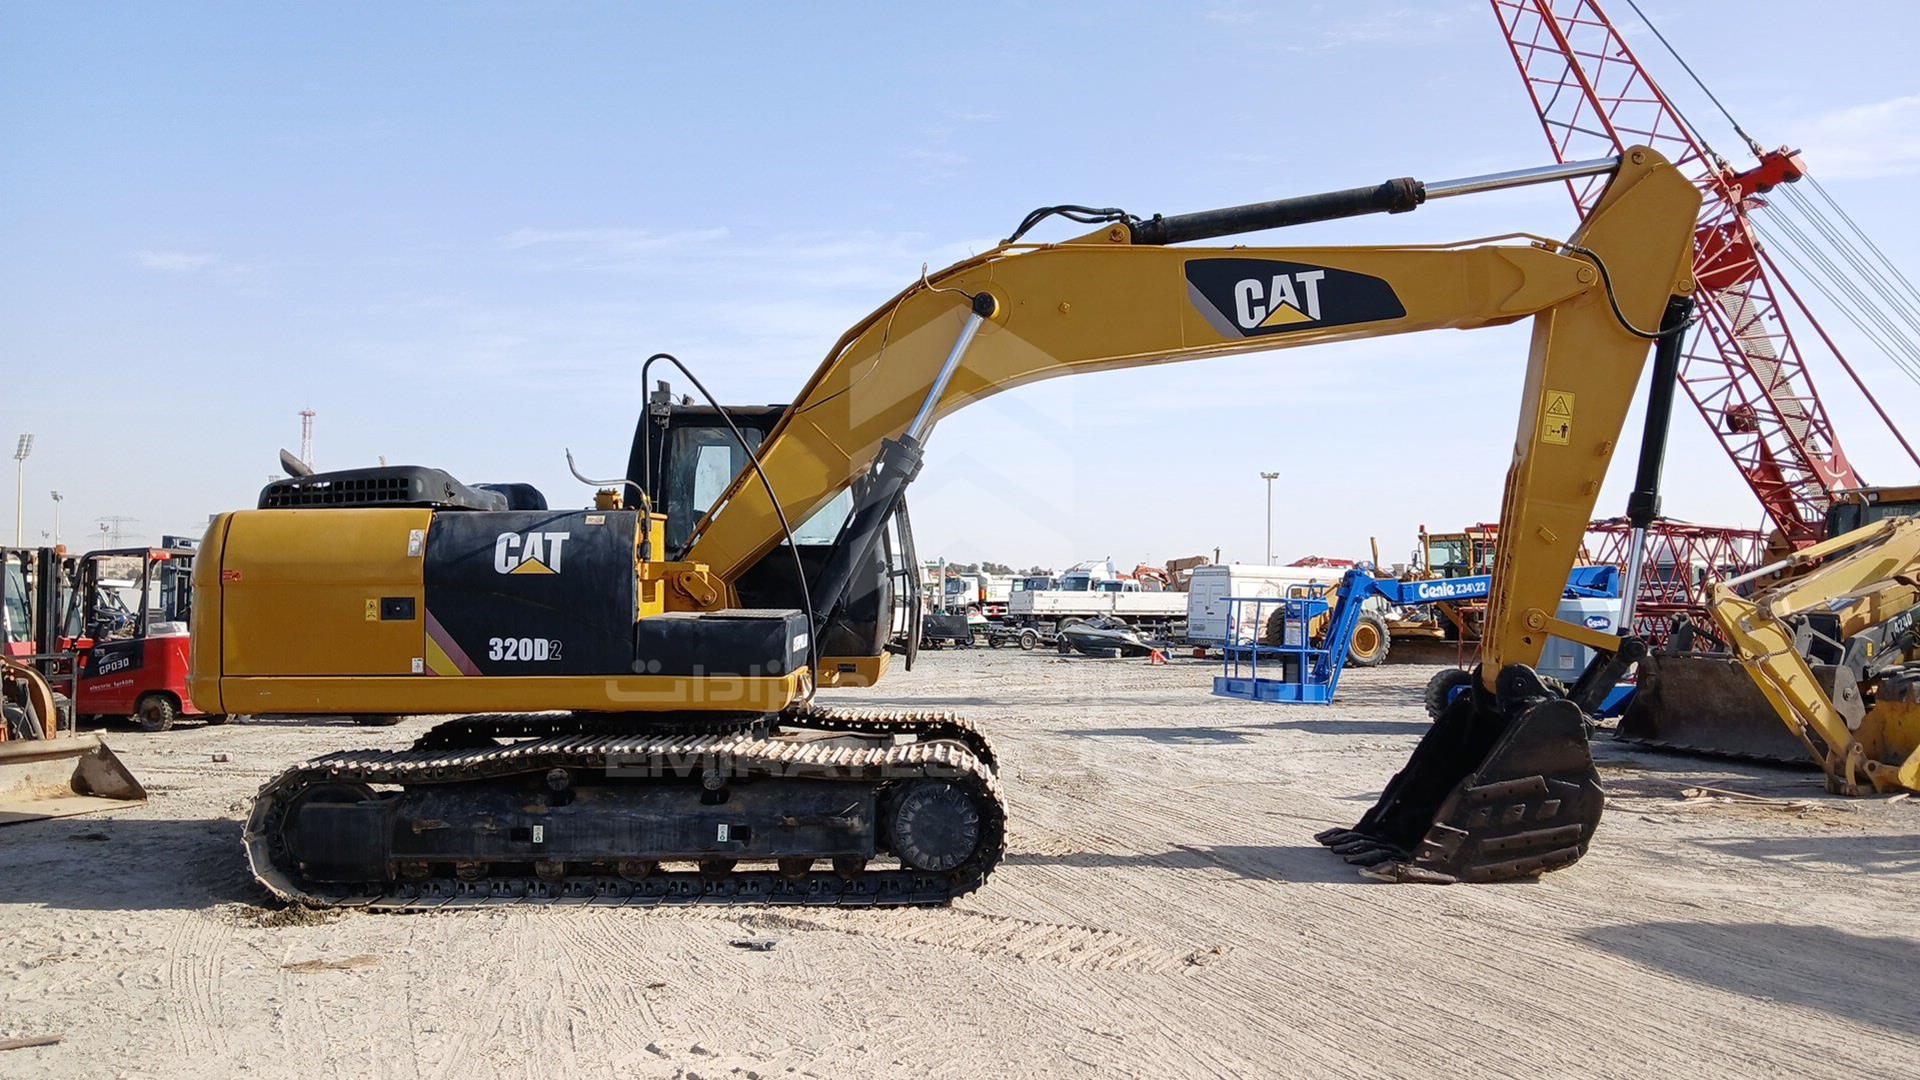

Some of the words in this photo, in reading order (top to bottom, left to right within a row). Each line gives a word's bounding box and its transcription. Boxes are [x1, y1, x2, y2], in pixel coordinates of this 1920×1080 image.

[1234, 269, 1325, 329] CAT
[494, 531, 570, 575] CAT
[1418, 581, 1455, 598] Genie
[1586, 618, 1609, 628] Genie
[488, 637, 563, 661] 320D2
